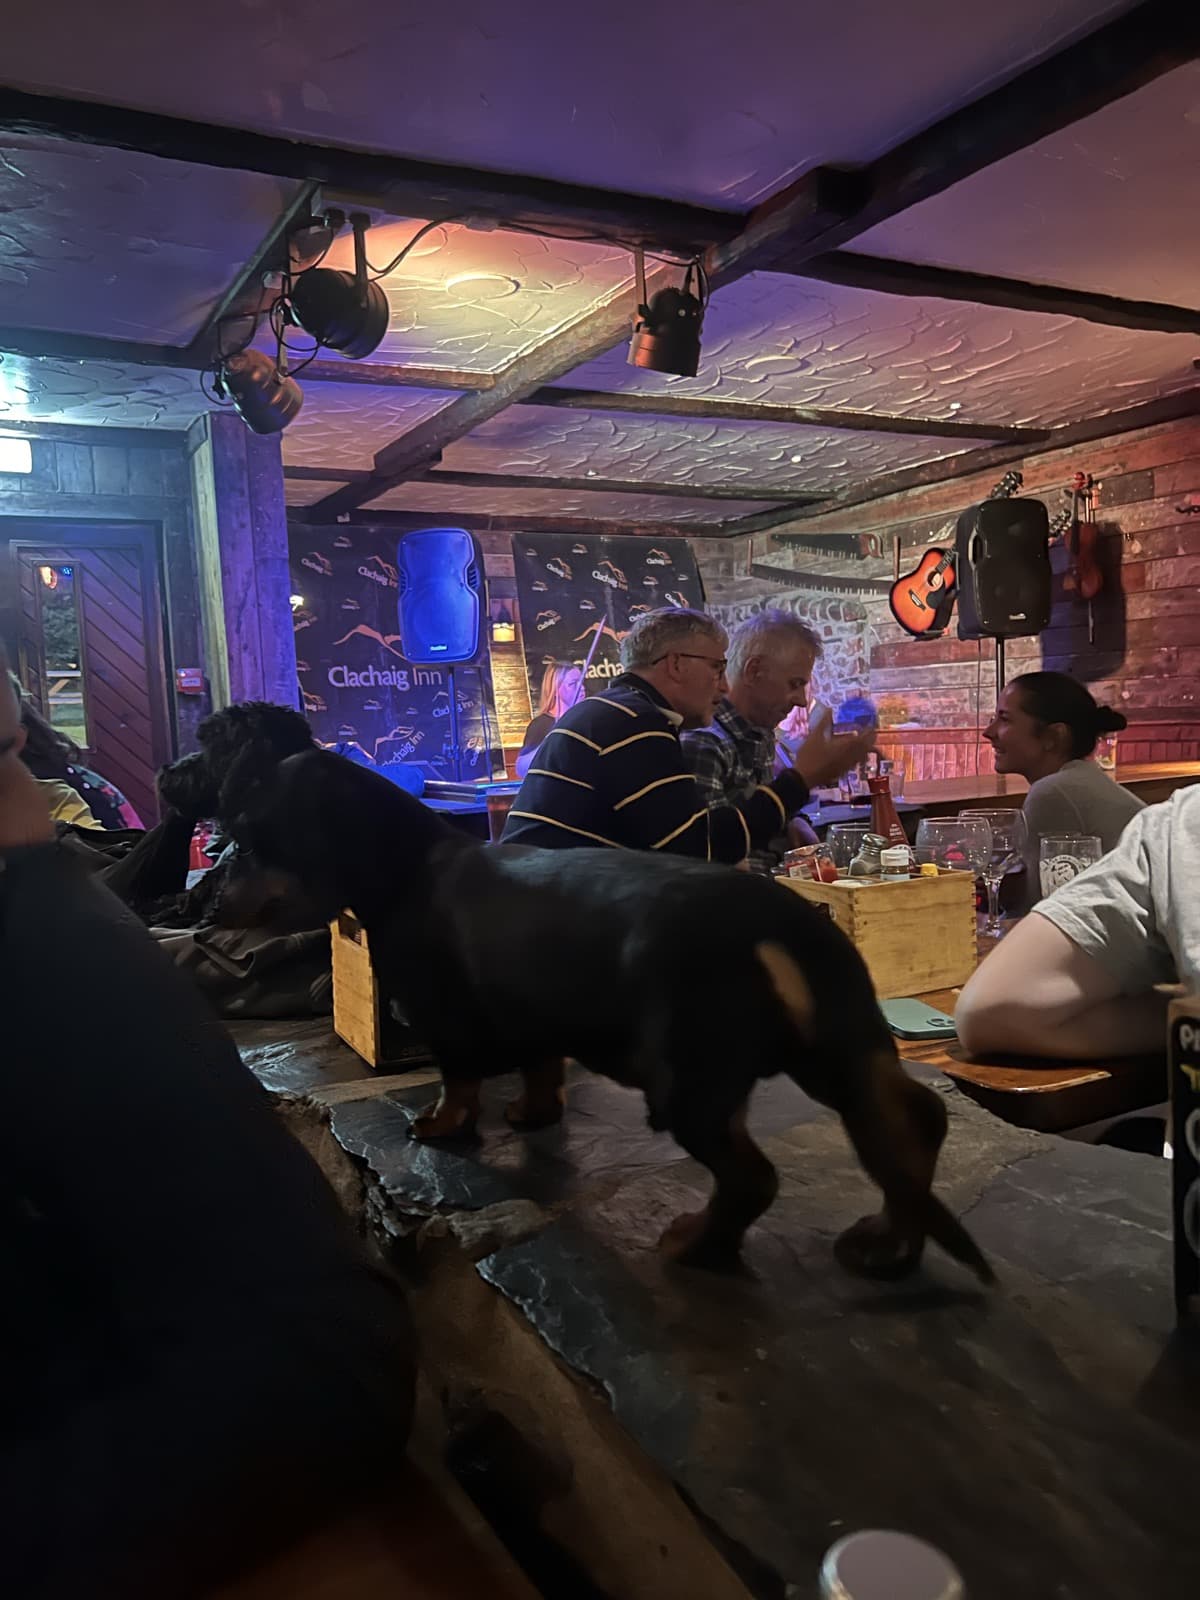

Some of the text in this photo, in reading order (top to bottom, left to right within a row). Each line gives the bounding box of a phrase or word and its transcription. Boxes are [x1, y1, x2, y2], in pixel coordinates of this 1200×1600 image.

[328, 665, 442, 691] Clachaig Inn
[573, 658, 625, 679] lacha
